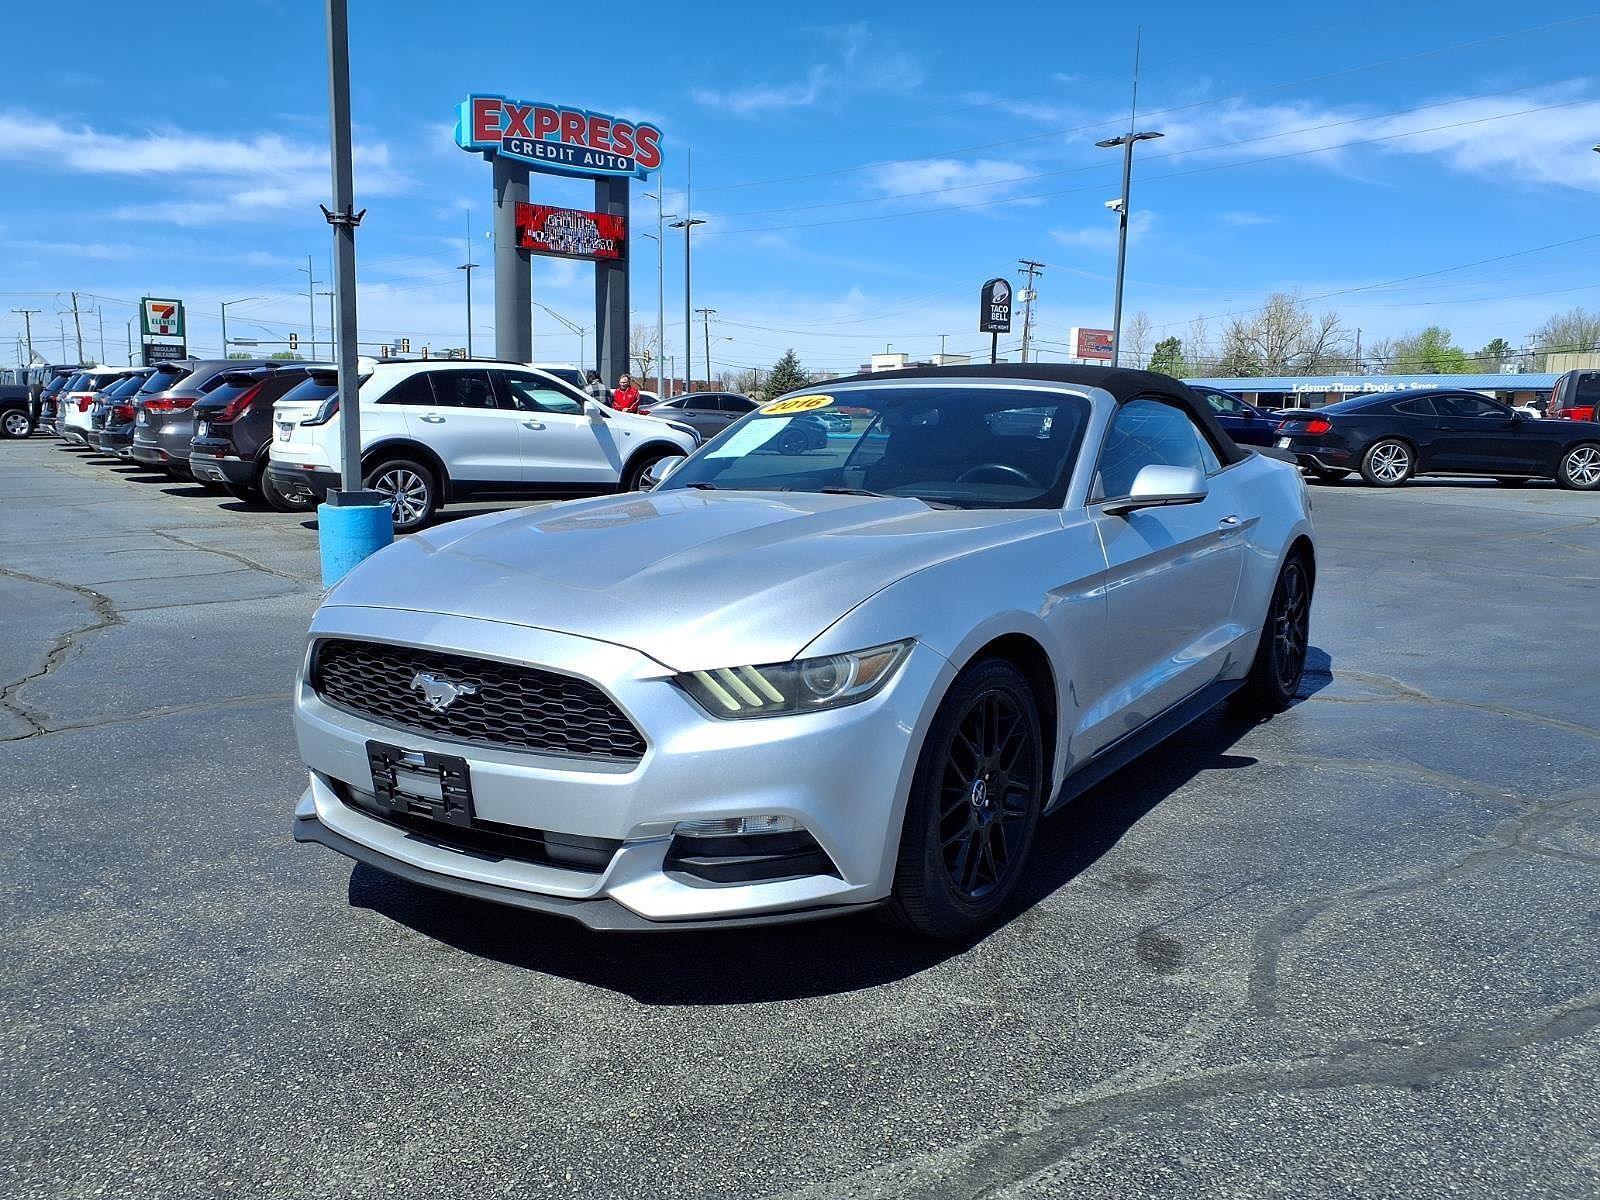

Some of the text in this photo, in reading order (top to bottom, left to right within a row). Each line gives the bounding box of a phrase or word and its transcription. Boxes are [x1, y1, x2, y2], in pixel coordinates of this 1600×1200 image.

[473, 99, 662, 169] EXPRESS
[510, 139, 628, 170] CREDIT AUTO
[151, 304, 175, 319] 7
[990, 304, 1009, 313] TACO
[991, 313, 1008, 321] BELL
[1292, 383, 1331, 393] Leisure
[1332, 383, 1360, 393] Time
[1363, 382, 1394, 393] Pools
[1396, 382, 1407, 390] &
[767, 398, 827, 412] 2016
